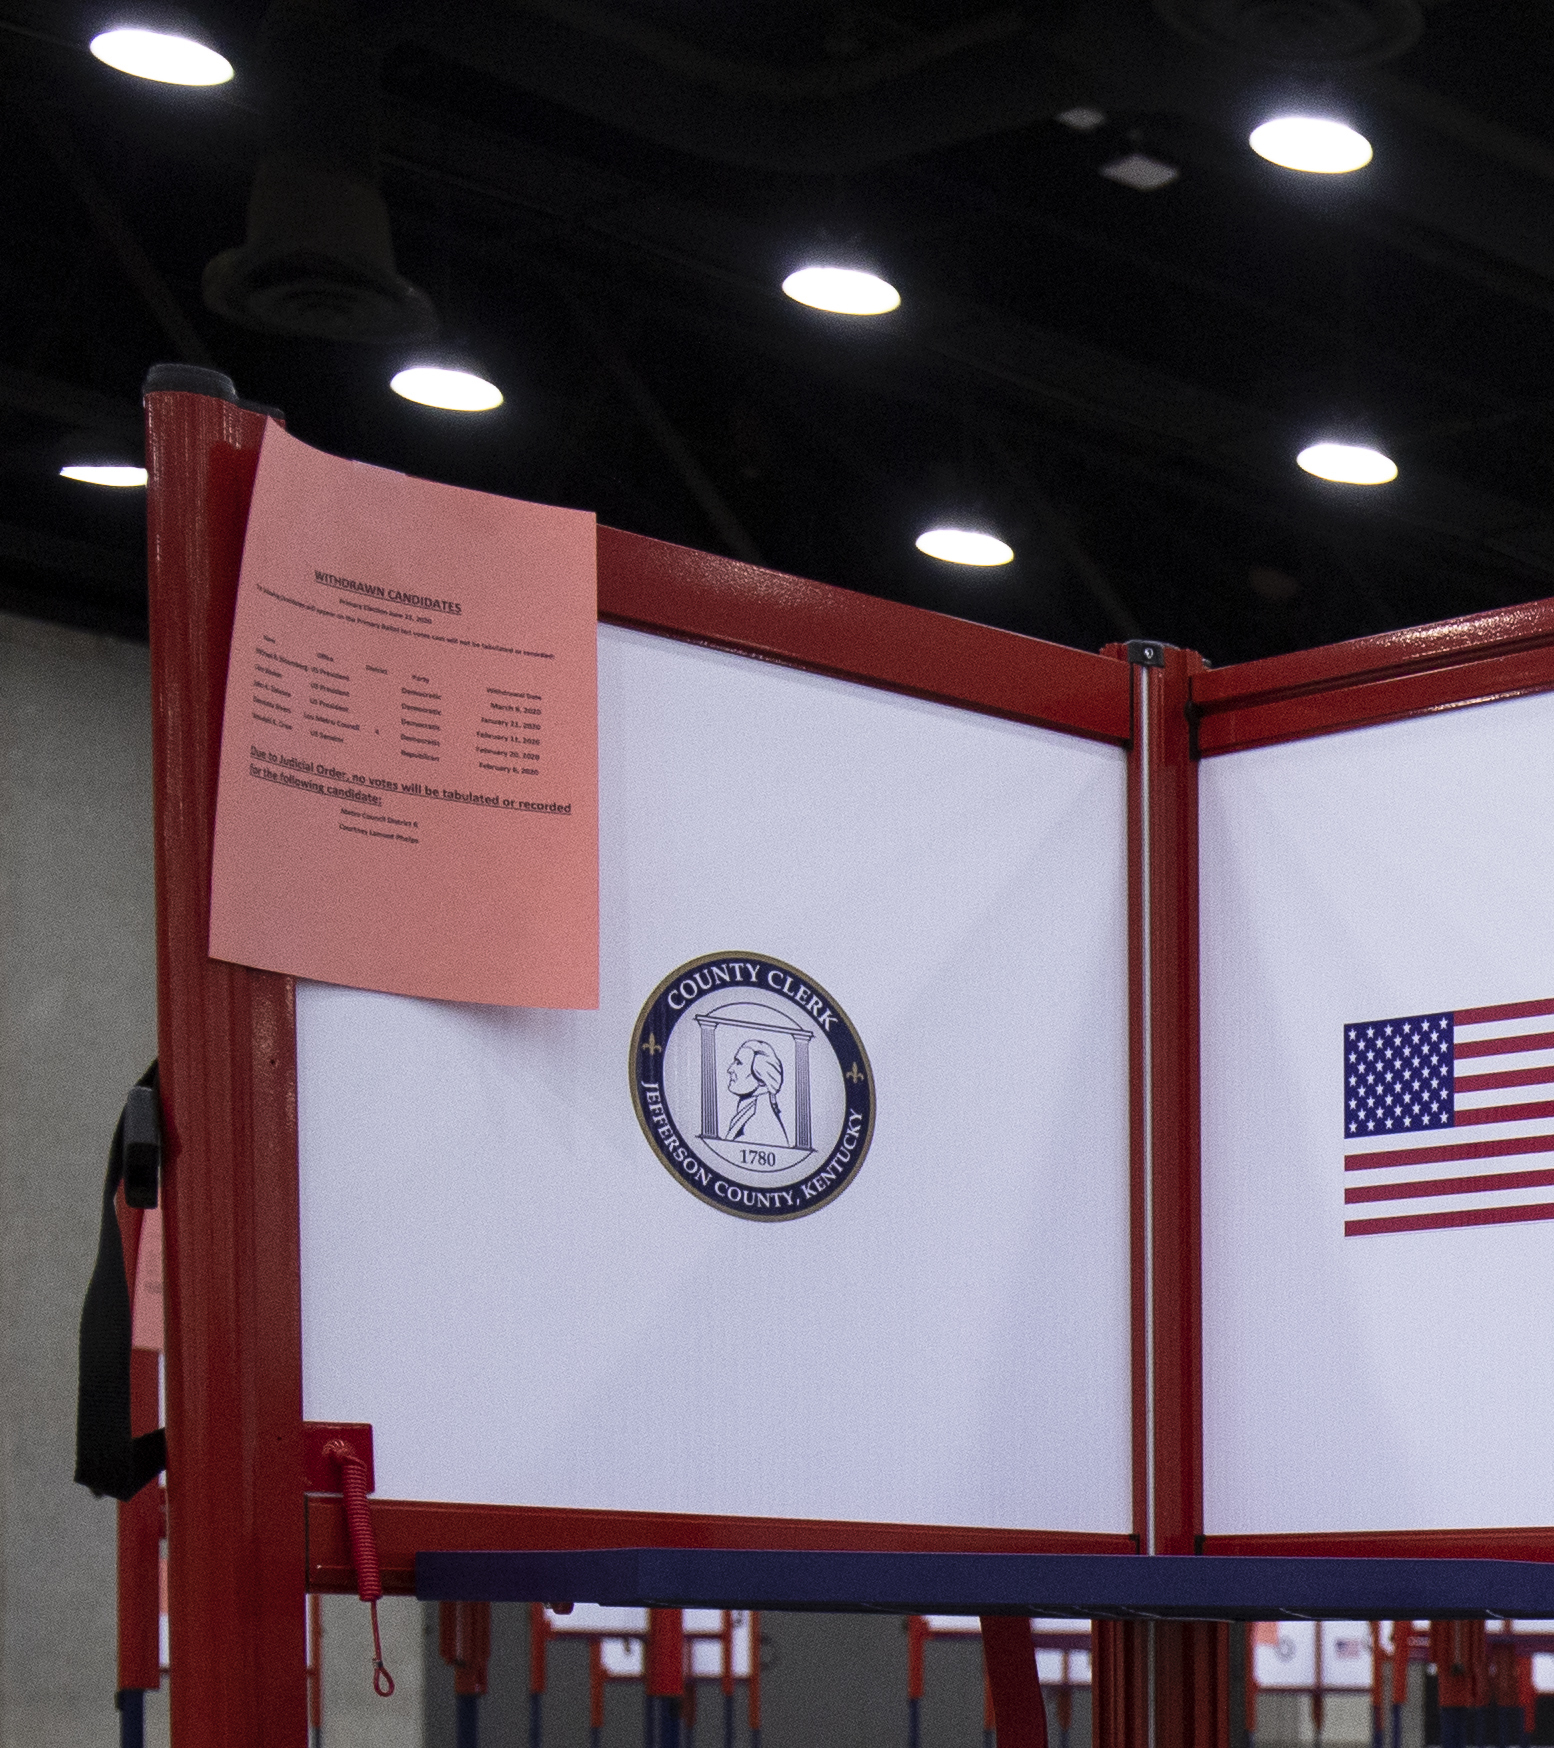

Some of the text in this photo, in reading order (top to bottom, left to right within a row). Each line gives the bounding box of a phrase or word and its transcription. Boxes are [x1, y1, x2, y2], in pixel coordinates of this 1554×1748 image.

[314, 569, 385, 598] WITHDRAWN
[387, 589, 462, 614] CANDIDATES
[250, 763, 261, 775] for
[263, 767, 278, 780] the
[280, 772, 324, 794] following
[250, 745, 572, 813] Due to Judicial Order, no votes will be tabulated or recorded
[667, 963, 838, 1032] COUNTY CLERK
[641, 1080, 863, 1208] JEFFERSON COUNTY, KENTUCKY
[739, 1149, 776, 1168] 1780
